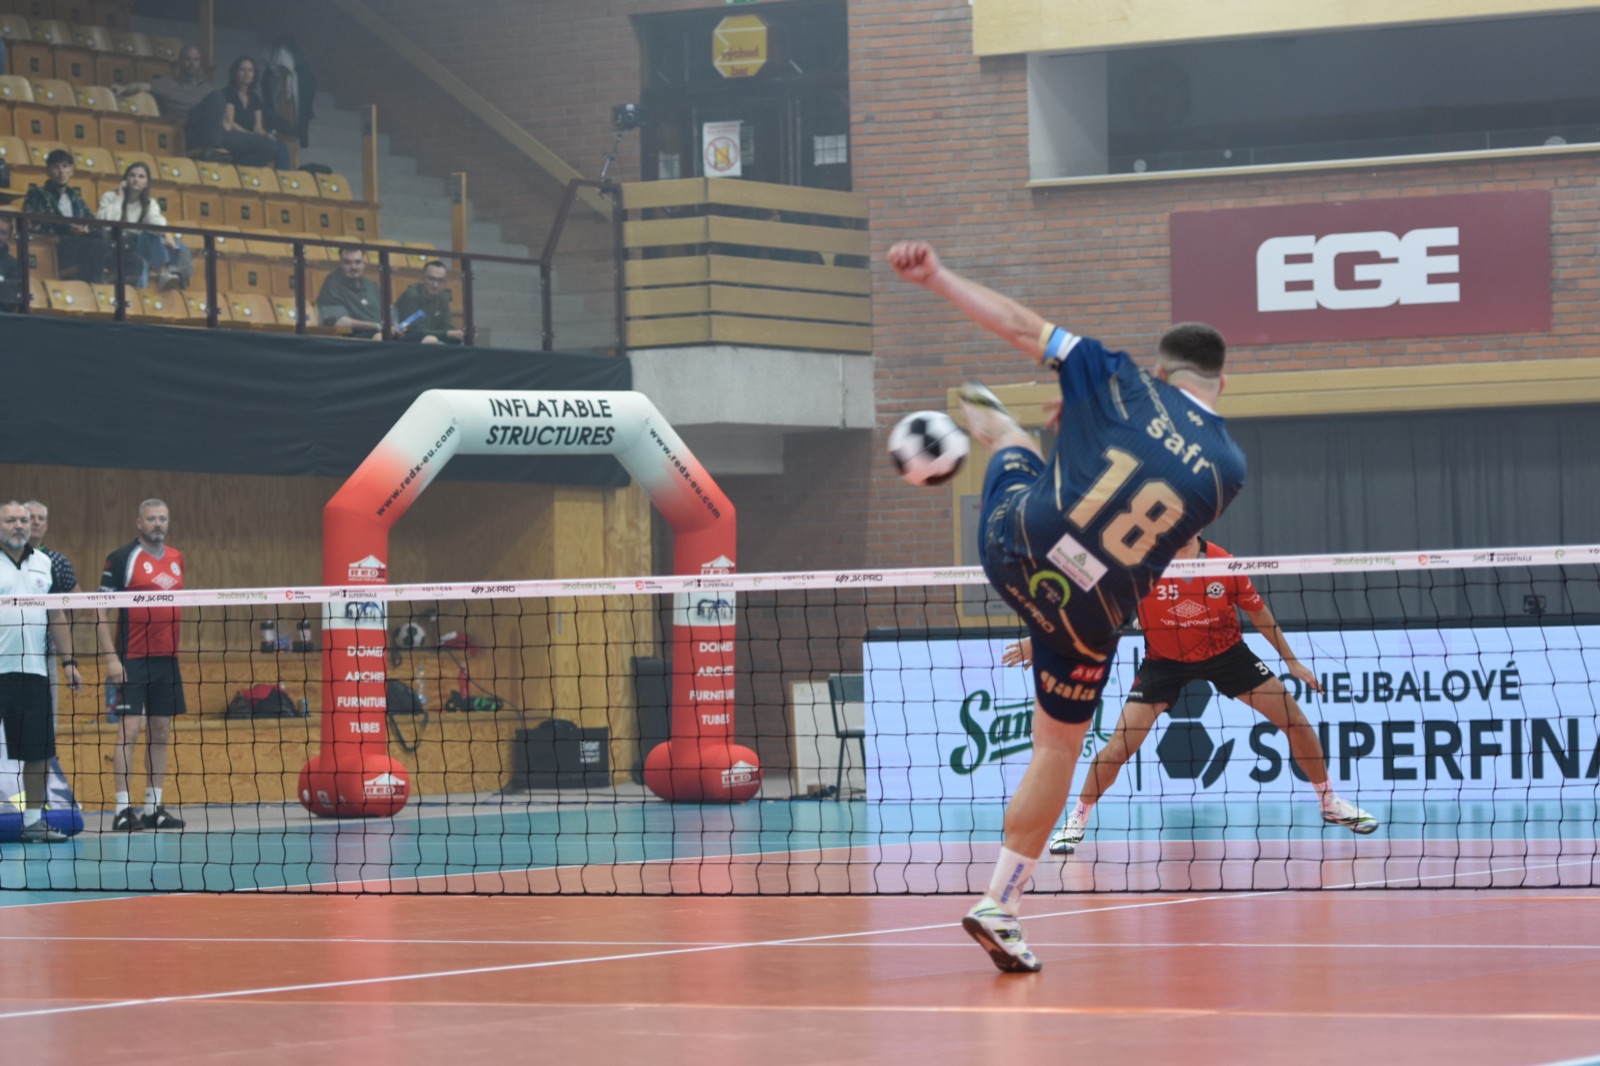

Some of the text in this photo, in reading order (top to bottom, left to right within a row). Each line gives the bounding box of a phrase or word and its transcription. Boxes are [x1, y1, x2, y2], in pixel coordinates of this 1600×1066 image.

[1256, 226, 1460, 312] EGE
[488, 398, 613, 418] INFLATABLE
[485, 425, 616, 446] STRUCTURES
[376, 425, 456, 516] www.redx-eu.com
[650, 428, 721, 519] www.redx-eu.com
[1065, 446, 1187, 569] 18
[143, 561, 153, 574] 9
[1156, 584, 1179, 601] 35
[1277, 661, 1520, 704] OHEJBALOVÉ
[350, 722, 381, 733] TUBES
